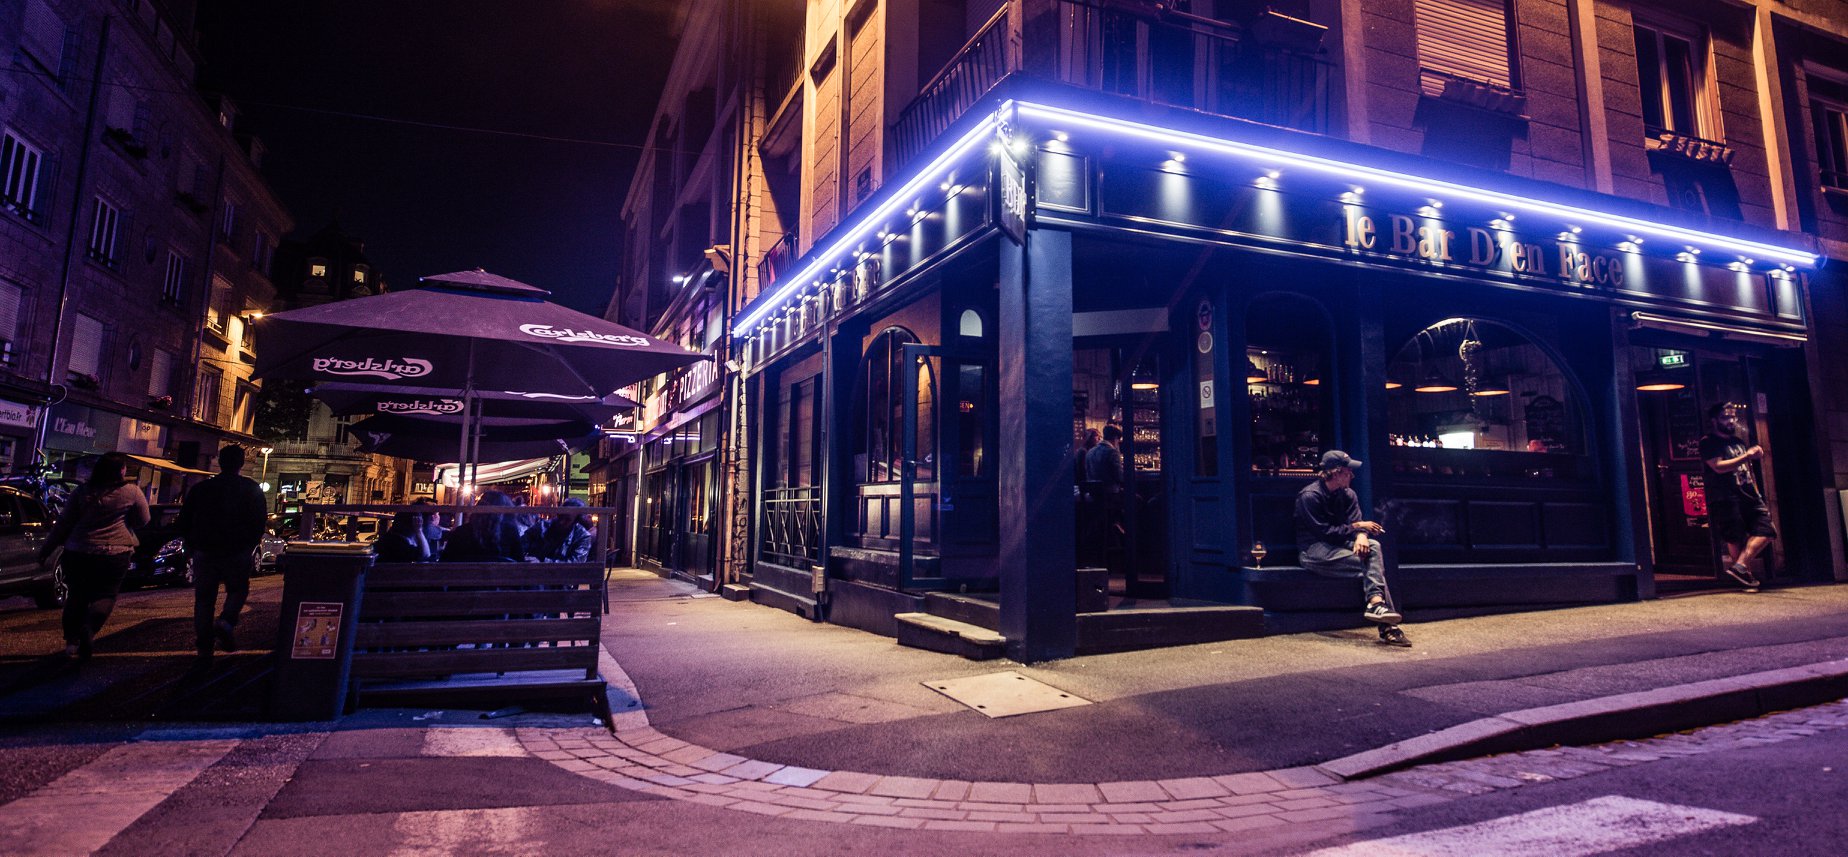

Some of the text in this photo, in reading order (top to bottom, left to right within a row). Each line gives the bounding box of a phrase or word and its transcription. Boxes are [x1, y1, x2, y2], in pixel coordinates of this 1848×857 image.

[1342, 205, 1624, 287] le Bar D'en Face
[519, 323, 650, 347] Carlsberg
